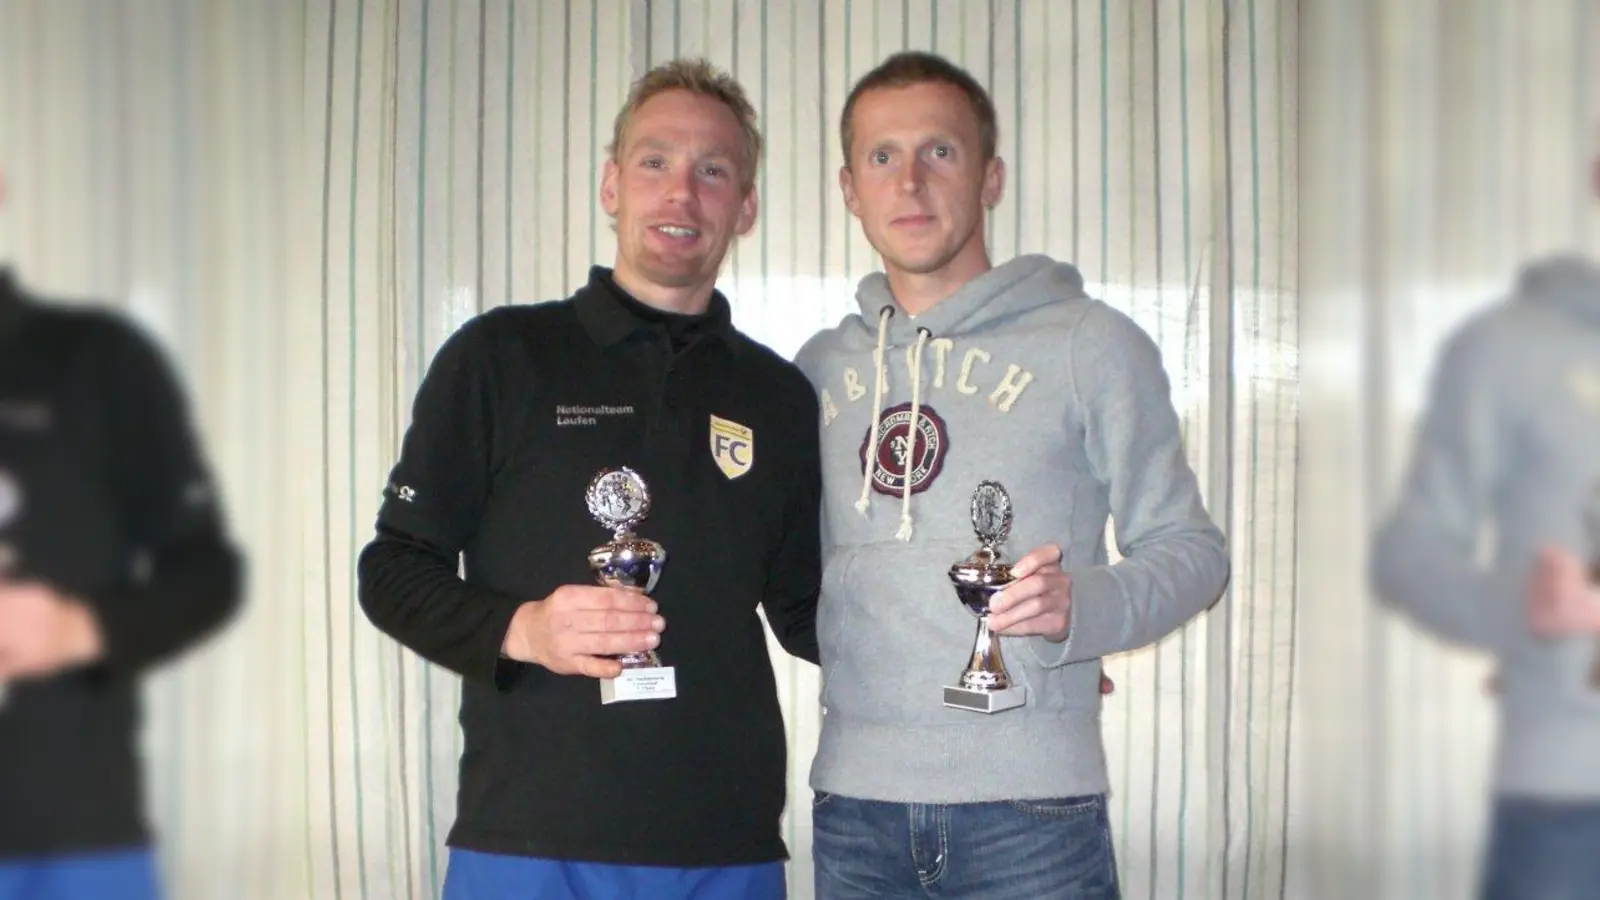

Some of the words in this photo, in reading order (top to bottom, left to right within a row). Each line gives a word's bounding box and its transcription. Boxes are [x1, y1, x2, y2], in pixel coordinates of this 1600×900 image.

[556, 404, 634, 414] Nationalteam
[556, 416, 597, 426] Laufen
[715, 433, 748, 467] FC
[874, 468, 896, 485] NEW
[909, 465, 929, 483] ORK
